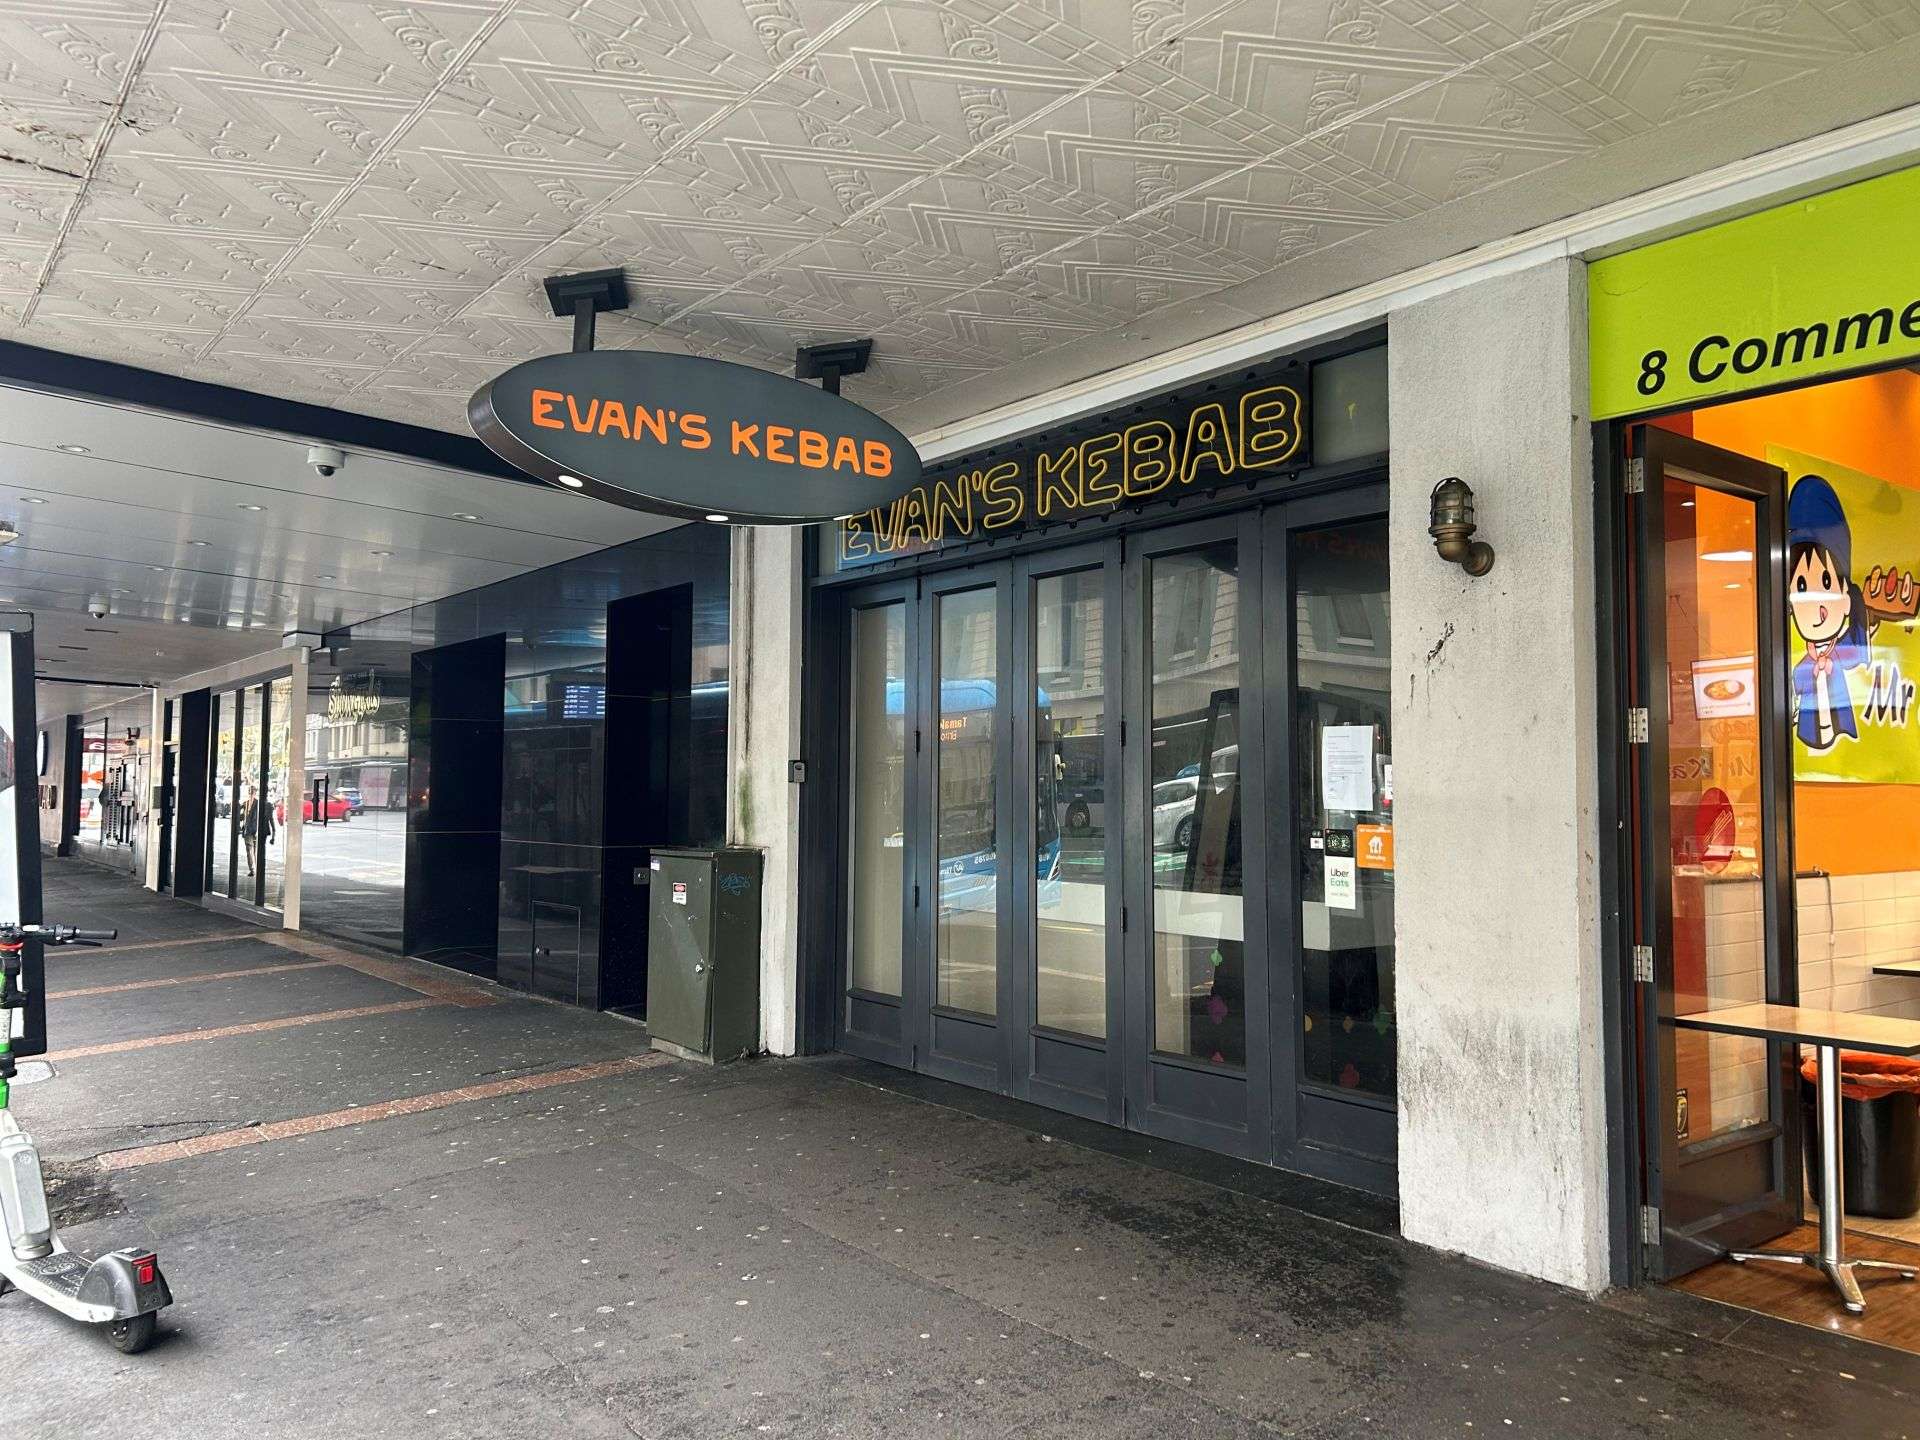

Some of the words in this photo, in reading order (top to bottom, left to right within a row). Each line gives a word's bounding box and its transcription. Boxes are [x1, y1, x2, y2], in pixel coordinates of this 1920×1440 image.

[1637, 349, 1668, 396] 8
[531, 388, 712, 450] EVAN'S
[731, 421, 894, 478] KEBAB
[842, 461, 1025, 561] EVAN'S
[1037, 385, 1302, 517] KEBAB
[1863, 664, 1914, 724] Mr
[1330, 867, 1350, 877] Uber
[1330, 878, 1350, 887] Eats
